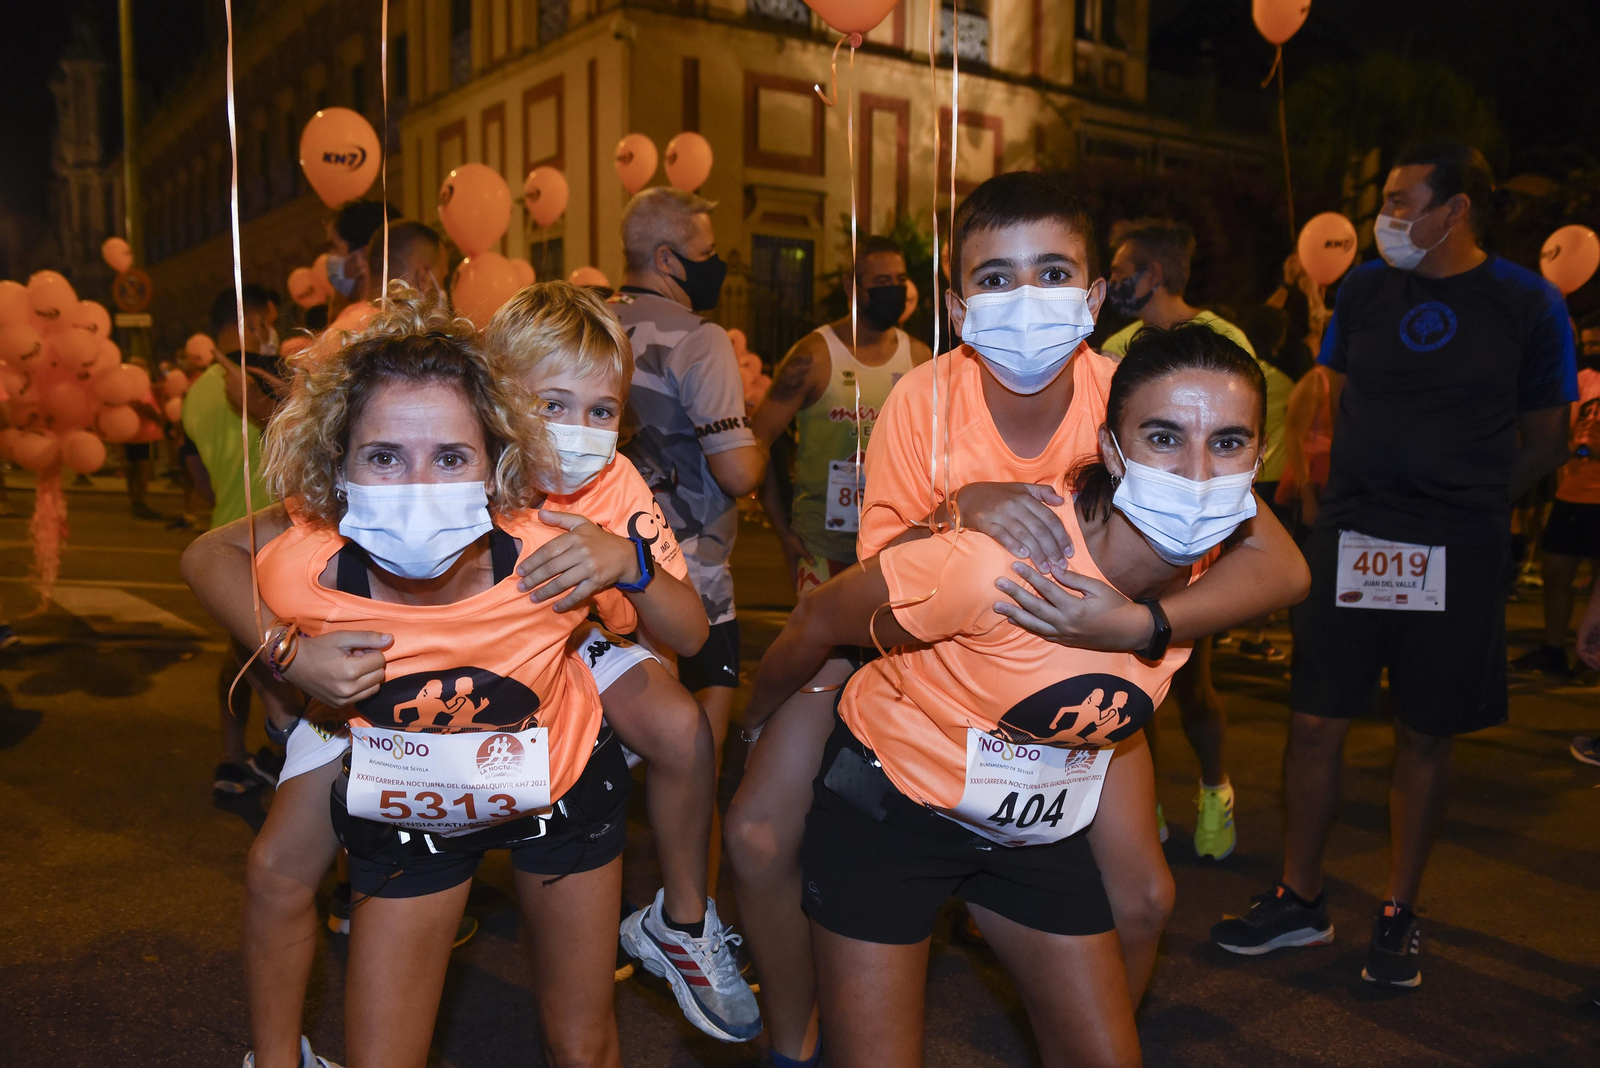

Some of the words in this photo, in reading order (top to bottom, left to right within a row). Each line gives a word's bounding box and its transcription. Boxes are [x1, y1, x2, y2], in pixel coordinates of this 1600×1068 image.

[1353, 551, 1427, 577] 4019
[1381, 580, 1394, 588] DEL
[1395, 580, 1417, 588] VALLE
[356, 773, 375, 782] XXXIII
[375, 776, 405, 787] CARRERA
[406, 780, 445, 789] NOCTURNA
[461, 781, 514, 791] GUADALQUIVIR
[531, 779, 547, 787] 2021
[984, 777, 1008, 785] CARRERA
[1008, 780, 1041, 790] NOCTURNA
[1041, 780, 1050, 789] DEL
[1050, 777, 1082, 788] GUADALQUIVIR
[379, 790, 521, 820] 5313
[987, 788, 1068, 829] 404
